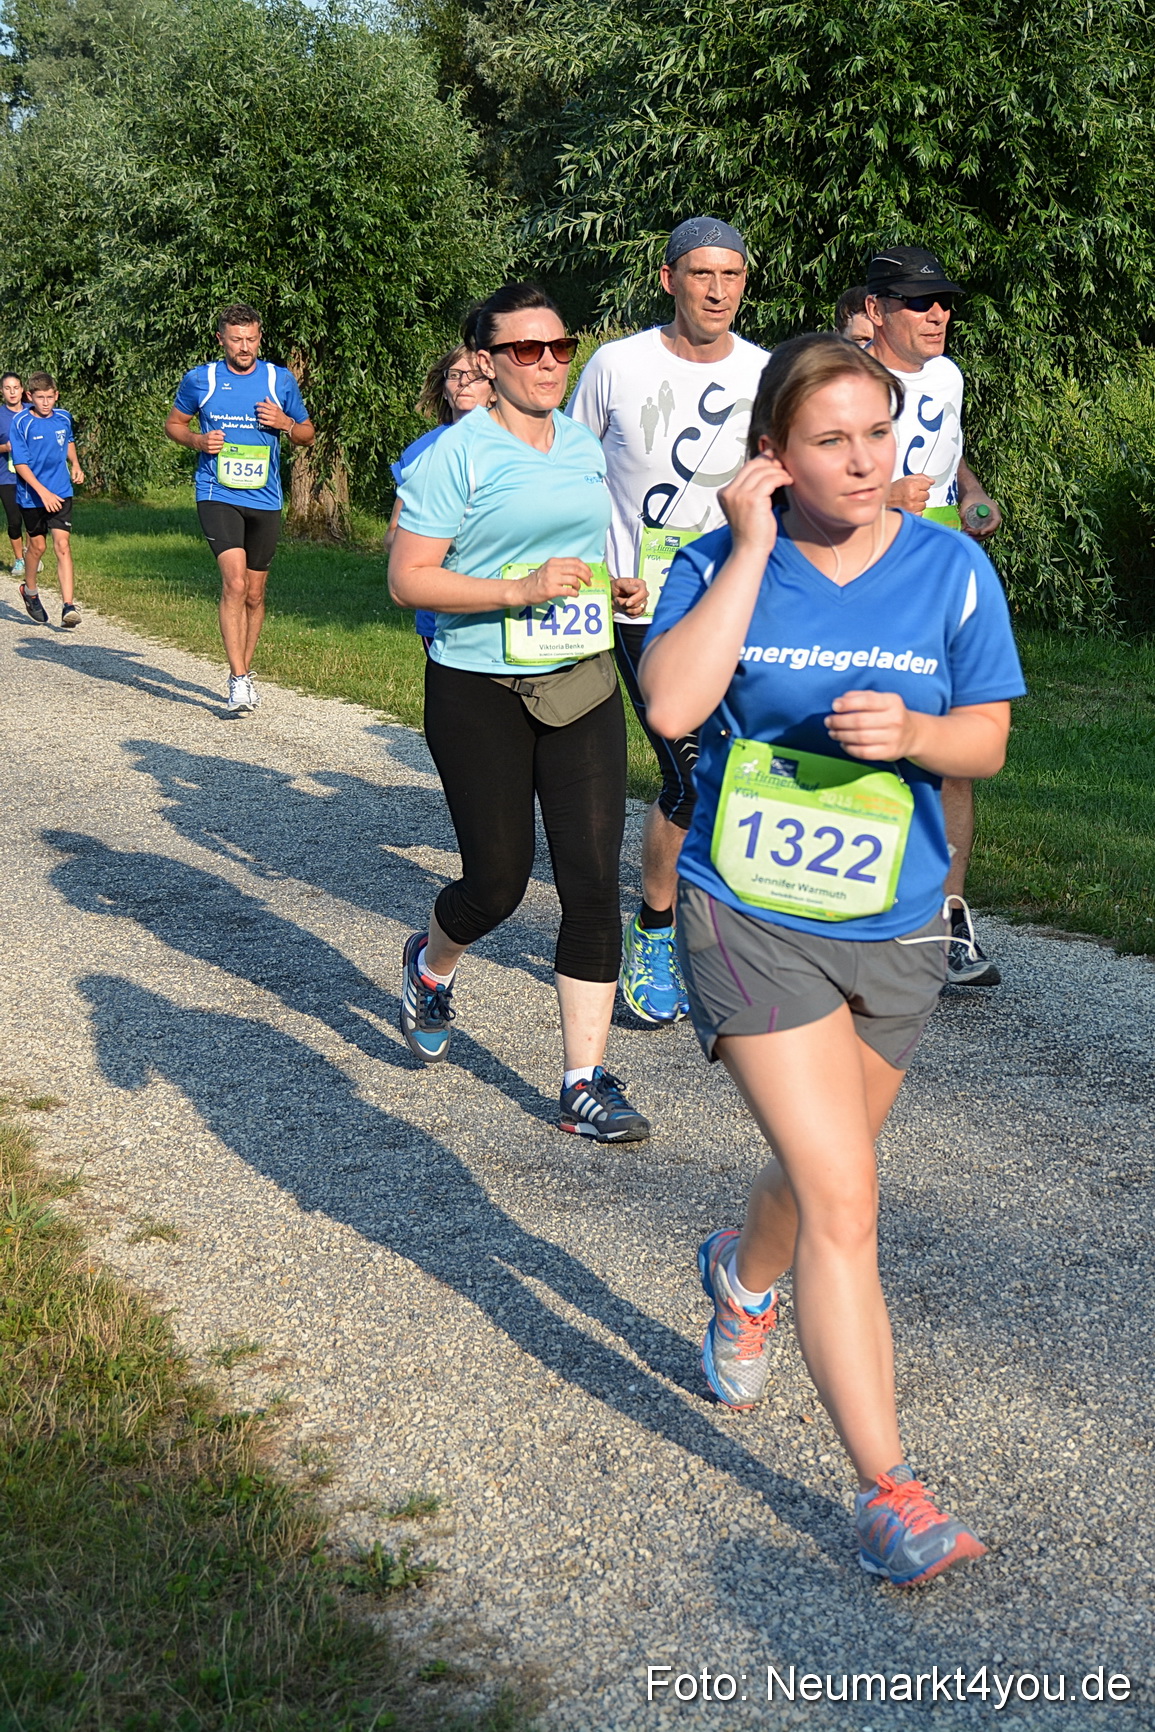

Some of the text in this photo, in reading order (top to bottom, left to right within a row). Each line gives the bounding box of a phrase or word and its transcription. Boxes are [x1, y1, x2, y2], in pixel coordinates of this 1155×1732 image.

[223, 460, 264, 477] 1354
[518, 603, 603, 637] 1428
[736, 645, 938, 676] energiegeladen
[754, 771, 820, 793] firmenlauf
[818, 791, 854, 807] 2015
[738, 810, 883, 884] 1322
[751, 873, 796, 891] Jennifer
[797, 883, 847, 900] Warmuth
